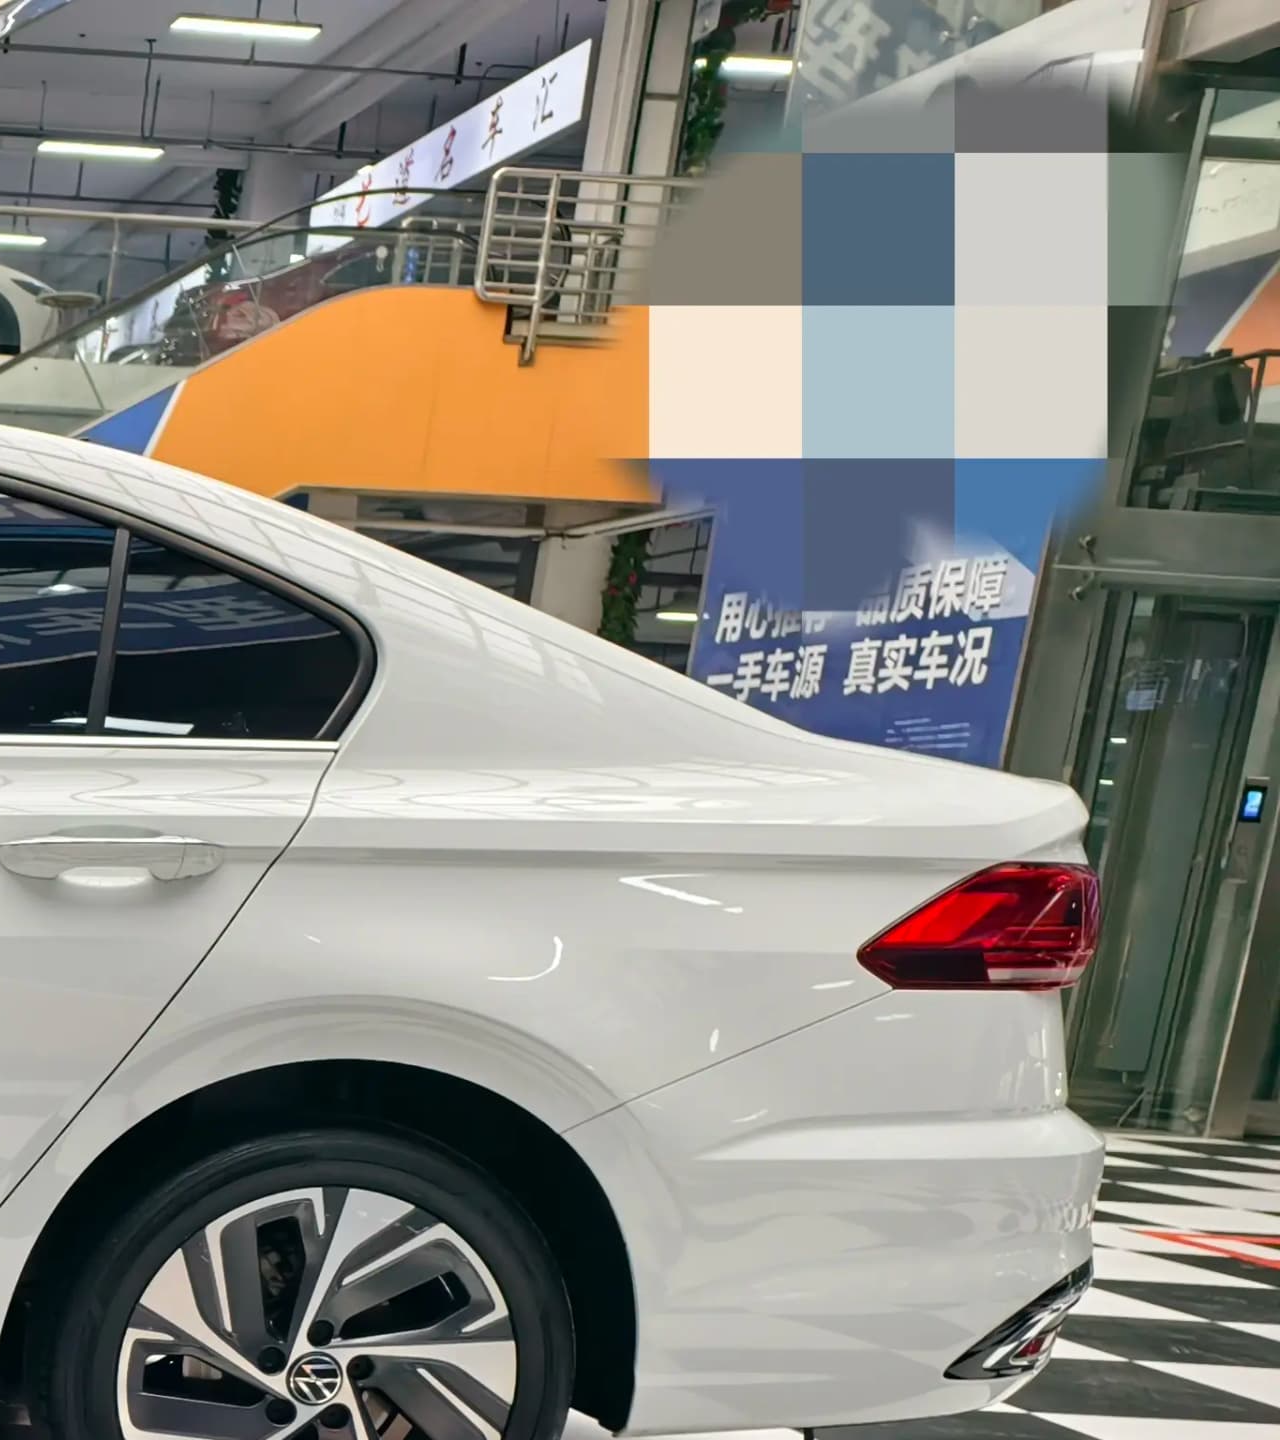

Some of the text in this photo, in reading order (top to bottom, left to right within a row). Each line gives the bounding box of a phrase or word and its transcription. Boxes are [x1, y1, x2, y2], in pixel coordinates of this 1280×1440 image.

[706, 626, 993, 702] 一手车源 真实车况
